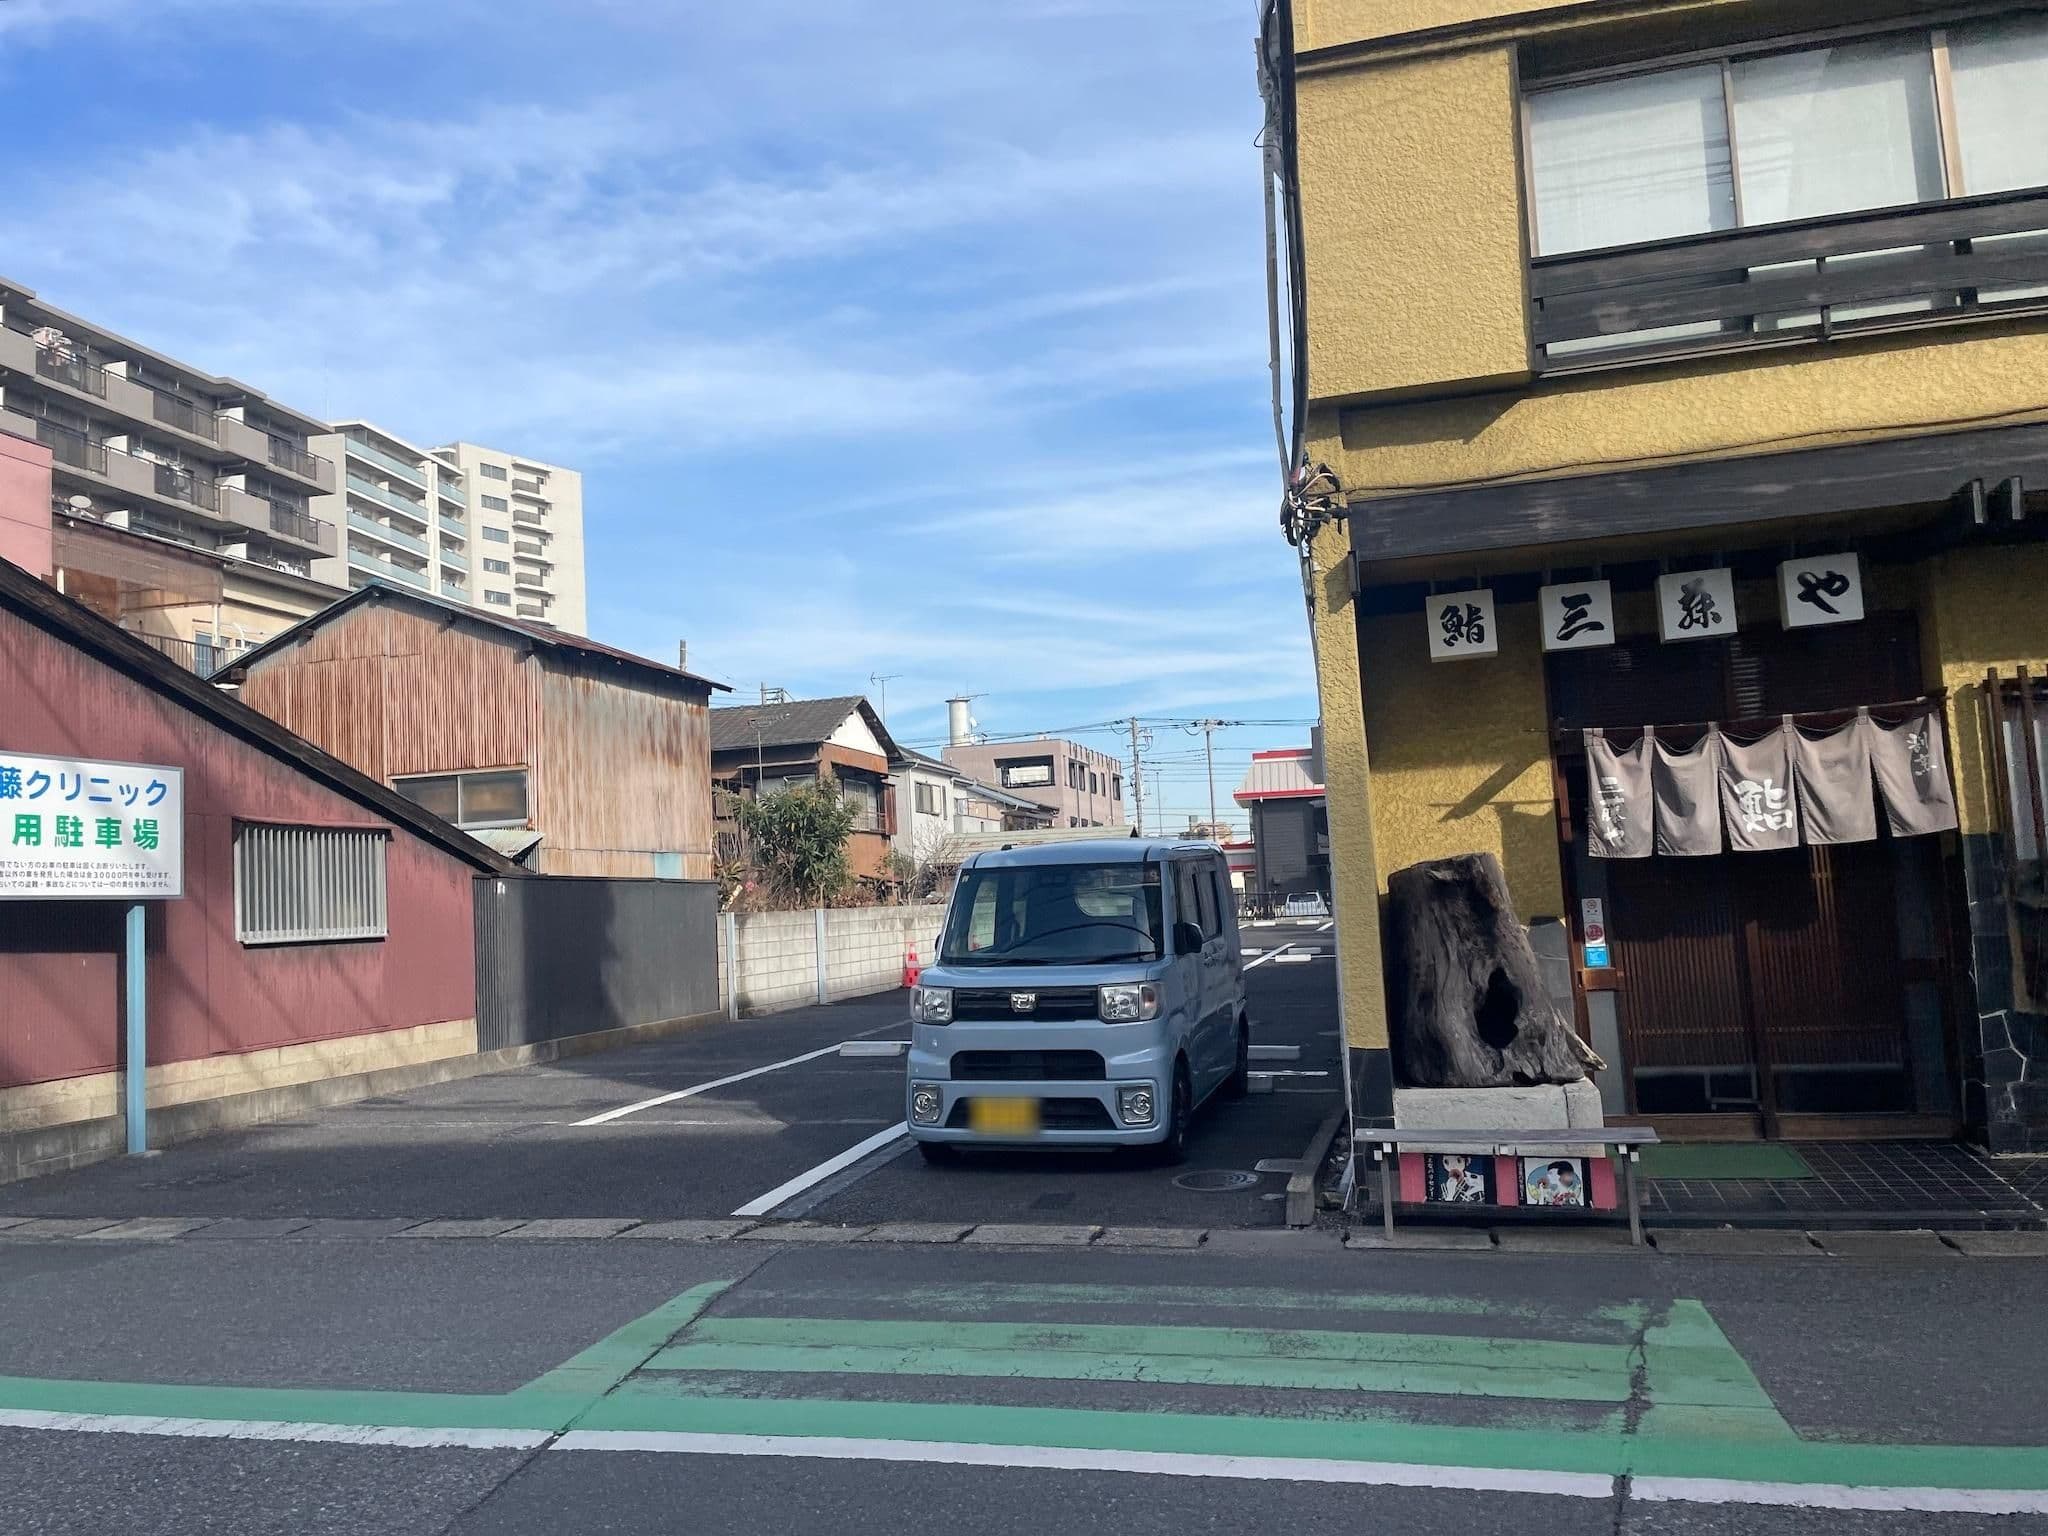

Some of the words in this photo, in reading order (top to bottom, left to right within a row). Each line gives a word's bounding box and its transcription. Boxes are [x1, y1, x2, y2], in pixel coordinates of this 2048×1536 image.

[0, 765, 168, 806] 藤クリニック
[1733, 779, 1793, 832] 鮨
[12, 814, 160, 850] 用駐車場
